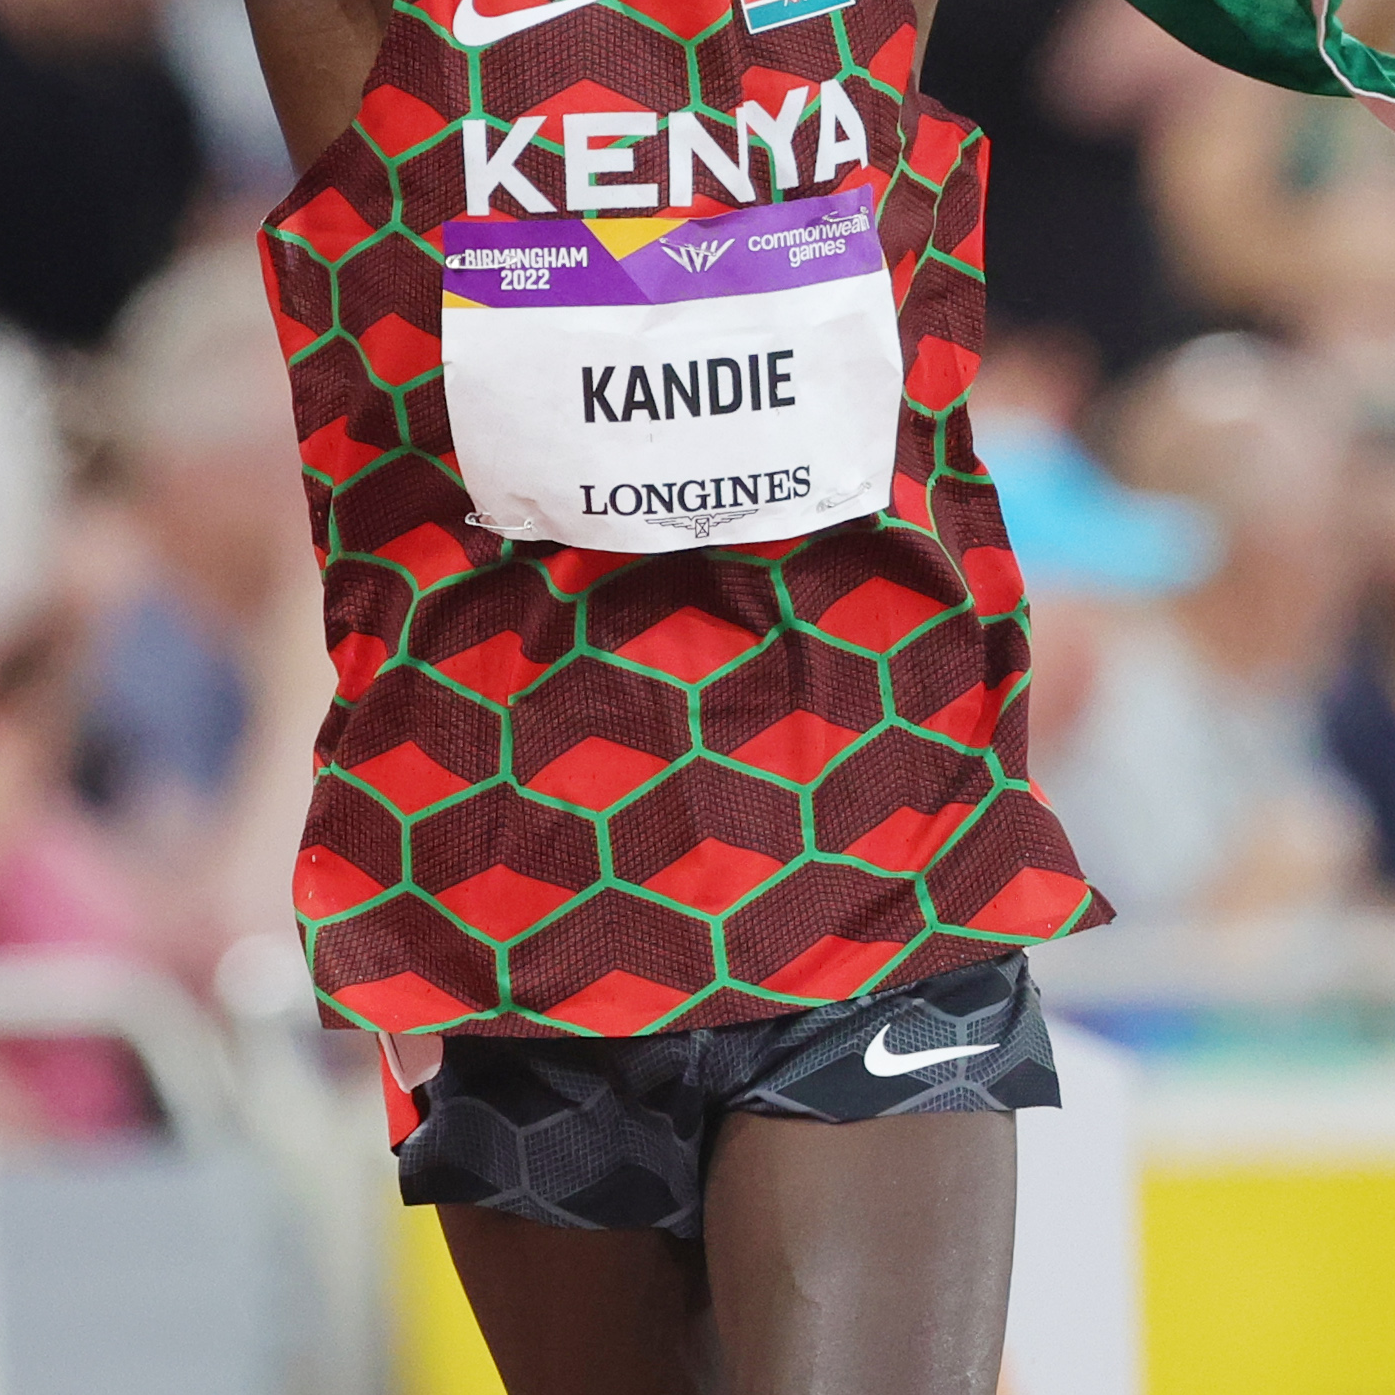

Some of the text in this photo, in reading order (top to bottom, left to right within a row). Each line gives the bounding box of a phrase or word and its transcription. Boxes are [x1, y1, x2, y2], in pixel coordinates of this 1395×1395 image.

[462, 79, 869, 216] KENYA
[464, 246, 588, 269] BIRMINGHAM
[788, 237, 846, 268] games
[500, 269, 551, 291] 2022
[581, 350, 796, 423] KANDIE
[579, 464, 812, 516] LONGINES
